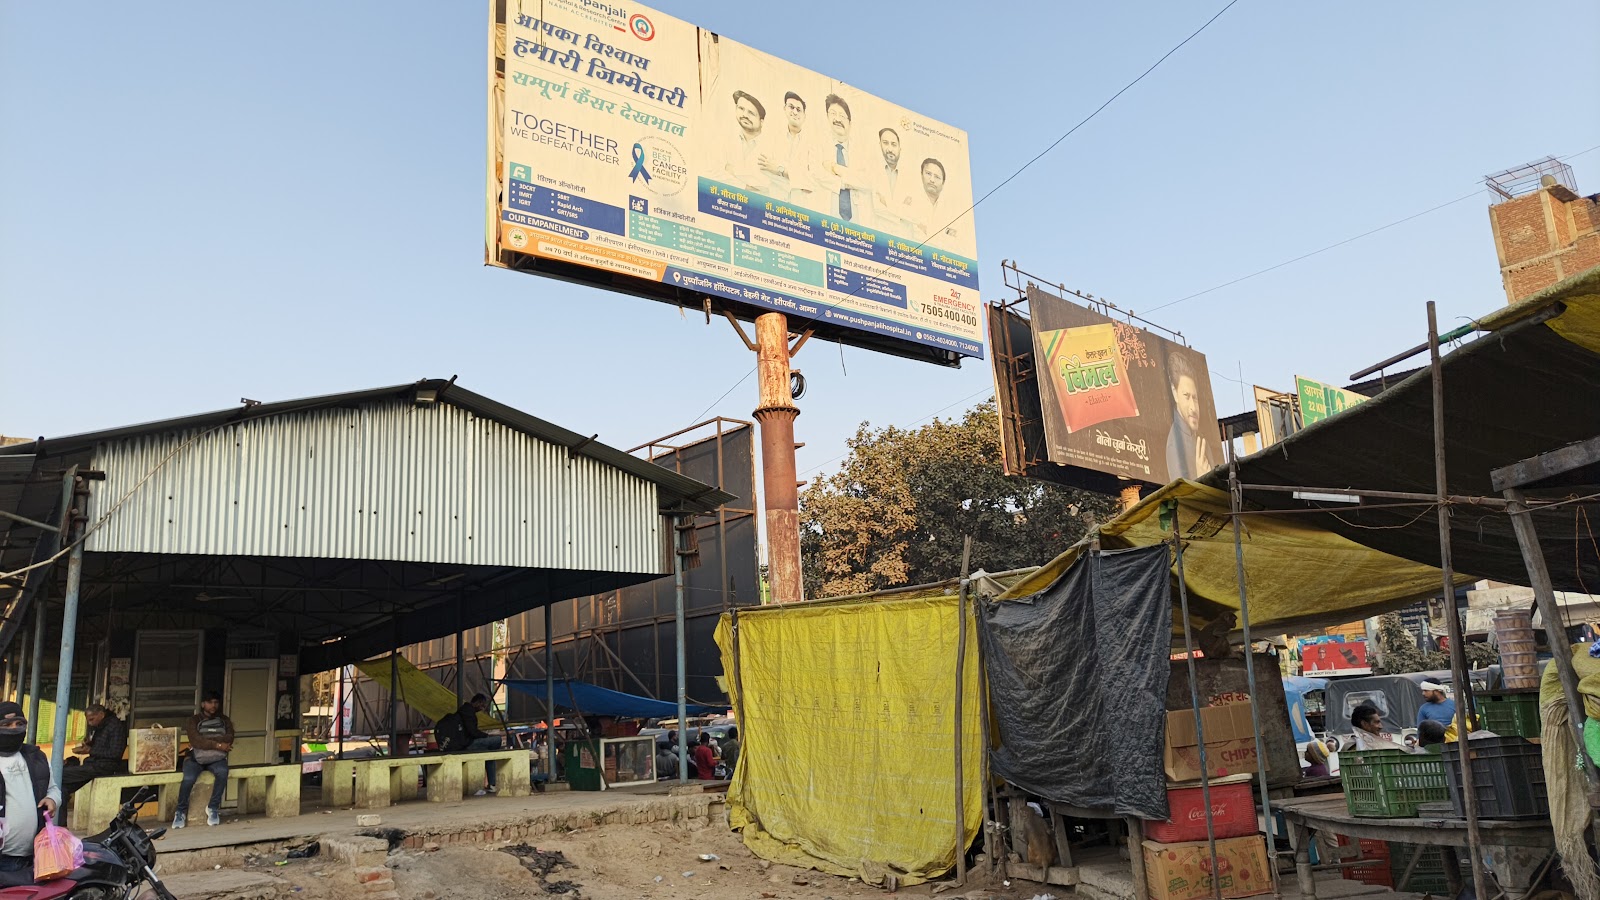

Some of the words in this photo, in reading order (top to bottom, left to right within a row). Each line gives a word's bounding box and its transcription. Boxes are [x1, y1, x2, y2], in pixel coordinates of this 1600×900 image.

[579, 5, 606, 19] Research
[580, 0, 626, 19] panjali
[514, 12, 581, 46] आपका
[584, 33, 651, 71] विश्वास
[513, 36, 583, 73] हमारी
[585, 57, 688, 109] जिम्मेदारी
[512, 69, 570, 101] सम्पूर्ण
[572, 87, 618, 115] कैंसर
[620, 102, 688, 138] देखभाल
[511, 110, 619, 156] TOGETHER
[510, 126, 529, 139] WE
[532, 132, 574, 152] DEFEAT
[576, 146, 620, 166] CANCER
[652, 151, 672, 163] BEST
[652, 158, 687, 175] CANCER
[652, 166, 681, 180] FACILITY
[518, 191, 533, 200] IMRT
[519, 182, 537, 193] 3DCRT
[518, 198, 532, 208] IGRT
[557, 200, 571, 211] Rapid
[571, 204, 584, 214] Arch
[508, 213, 526, 225] OUR
[527, 217, 585, 239] EMPANELMENT
[934, 294, 976, 312] EMERGENCY
[833, 312, 912, 336] www.pushpanjalihospital.in
[1058, 354, 1120, 395] विमल
[1308, 400, 1316, 412] 22
